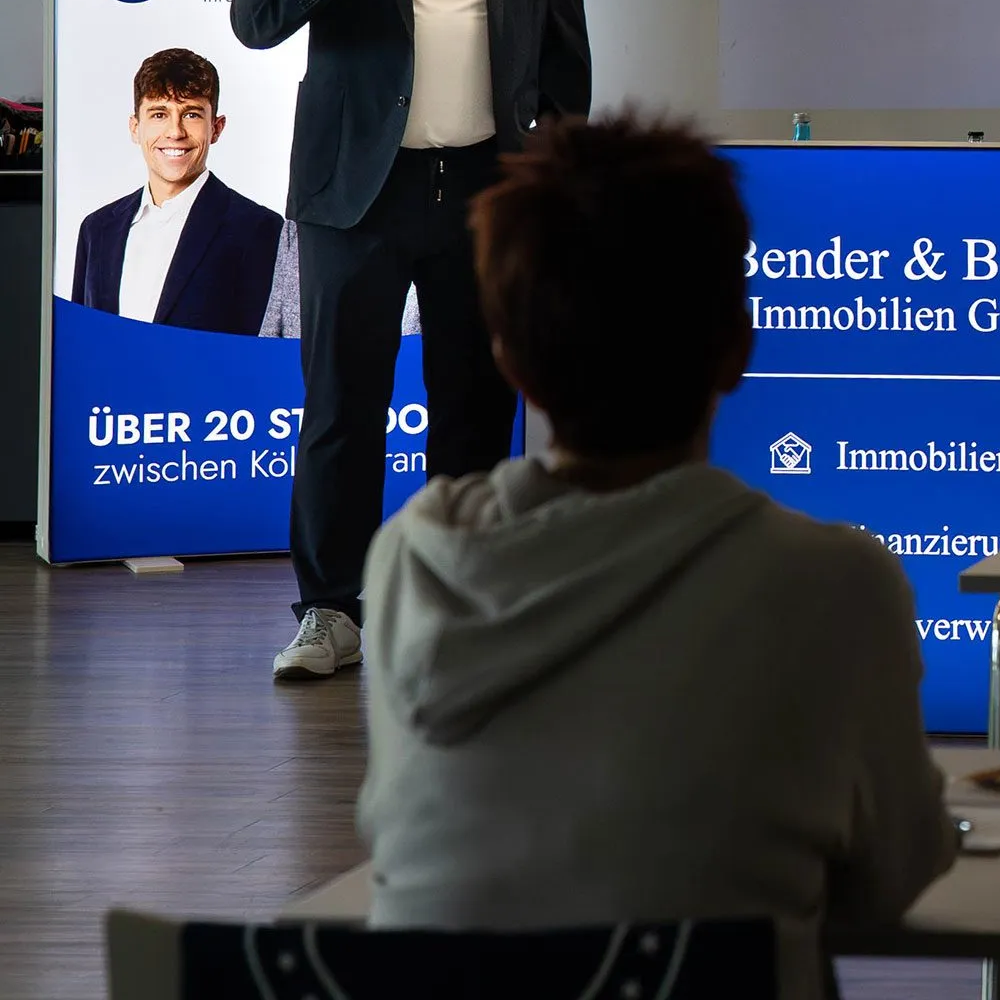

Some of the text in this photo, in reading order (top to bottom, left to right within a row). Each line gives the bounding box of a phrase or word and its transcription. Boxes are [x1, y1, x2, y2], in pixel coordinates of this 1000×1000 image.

[903, 237, 947, 281] &
[750, 296, 958, 332] Immobilien
[88, 406, 192, 447] ÜBER
[203, 409, 255, 442] 20
[93, 449, 237, 485] zwischen
